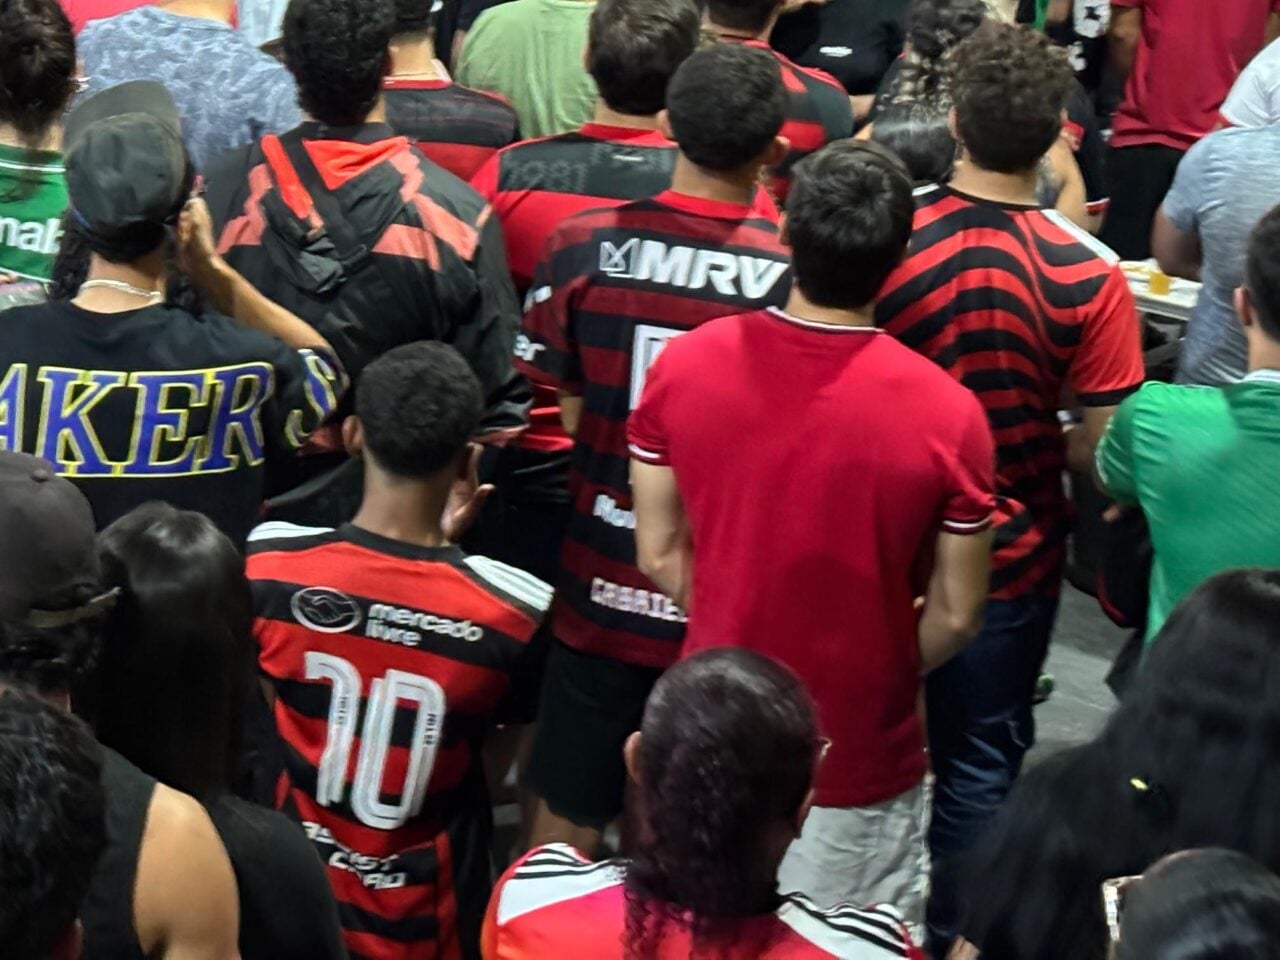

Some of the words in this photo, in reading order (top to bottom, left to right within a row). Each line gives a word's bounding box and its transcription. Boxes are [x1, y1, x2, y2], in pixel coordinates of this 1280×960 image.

[632, 240, 790, 300] MRV
[365, 618, 422, 647] livre
[368, 603, 484, 642] mercado
[304, 650, 447, 830] 10
